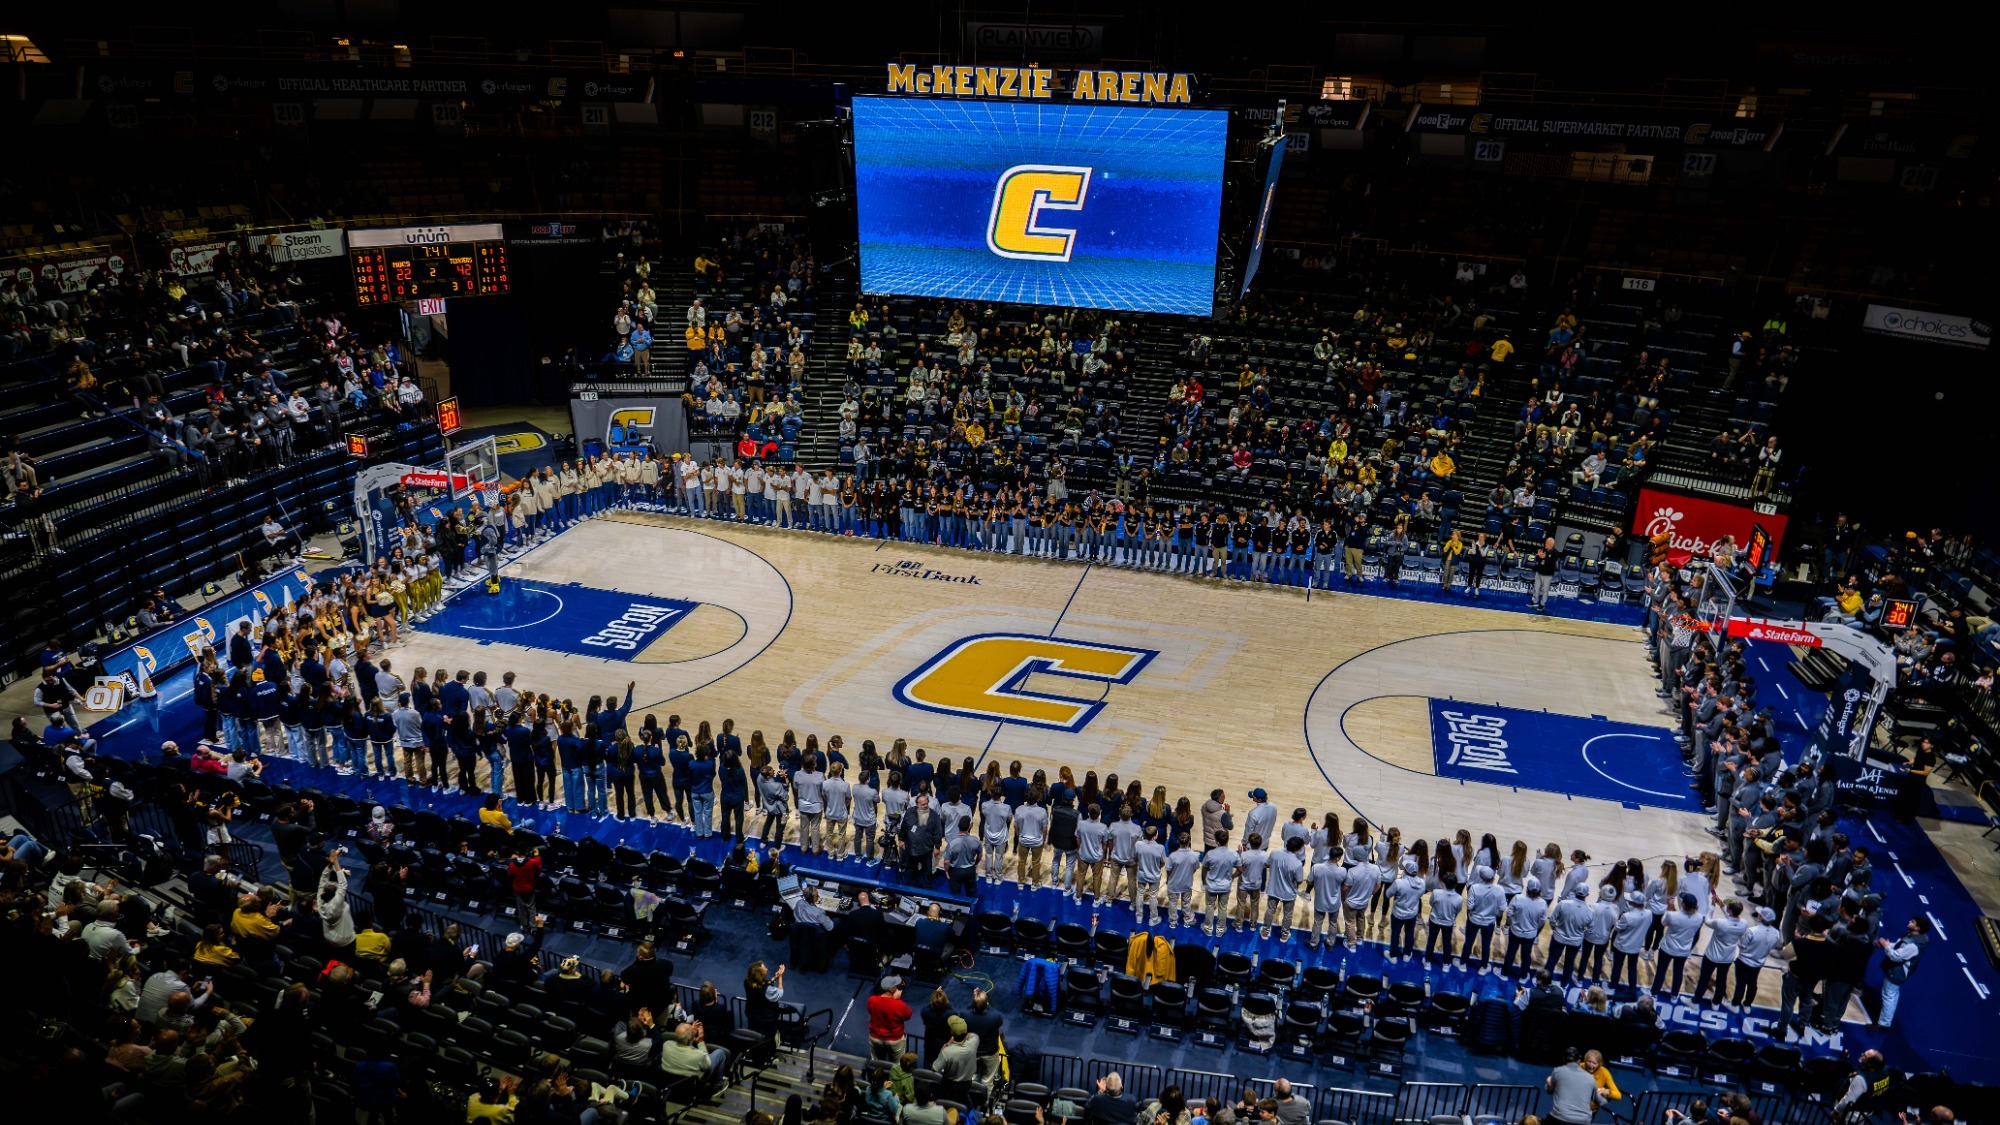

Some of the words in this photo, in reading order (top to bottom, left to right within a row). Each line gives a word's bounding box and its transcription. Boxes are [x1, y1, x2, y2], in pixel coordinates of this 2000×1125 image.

[983, 29, 1086, 47] PLAINVIEW
[279, 78, 329, 91] OFFICIAL
[332, 79, 410, 91] HEALTHCARE
[413, 80, 467, 92] PARTNER
[887, 63, 1052, 98] McKENZIE
[1073, 70, 1191, 103] ARENA
[434, 106, 458, 120] 210
[586, 109, 604, 122] 211
[753, 113, 773, 127] 212
[1495, 118, 1539, 131] OFFICIAL
[1542, 120, 1624, 136] SUPERMARKET
[1627, 124, 1680, 139] PARTNER
[1286, 135, 1306, 148] 215
[1479, 144, 1500, 159] 216
[1685, 155, 1712, 171] 217
[284, 234, 321, 247] Steam
[407, 229, 449, 244] unum
[288, 243, 332, 260] Logistics
[421, 246, 448, 257] 7:41
[396, 268, 412, 280] 22
[430, 268, 436, 277] 2
[457, 265, 472, 276] 42
[398, 285, 405, 295] 0
[411, 285, 418, 294] 2
[452, 281, 458, 291] 3
[467, 280, 474, 290] 0
[1628, 280, 1648, 290] 116
[421, 298, 443, 314] EXIT
[1903, 316, 1966, 338] choices
[582, 392, 597, 401] 112
[442, 411, 457, 430] 30
[352, 444, 363, 453] 30
[872, 564, 981, 585] FirstBank
[1893, 602, 1912, 613] 7:41
[1888, 612, 1905, 624] 30
[581, 603, 683, 650] SOCON
[1837, 703, 1853, 737] erlanger
[1439, 710, 1518, 774] SOCON
[1873, 785, 1898, 796] JENKI
